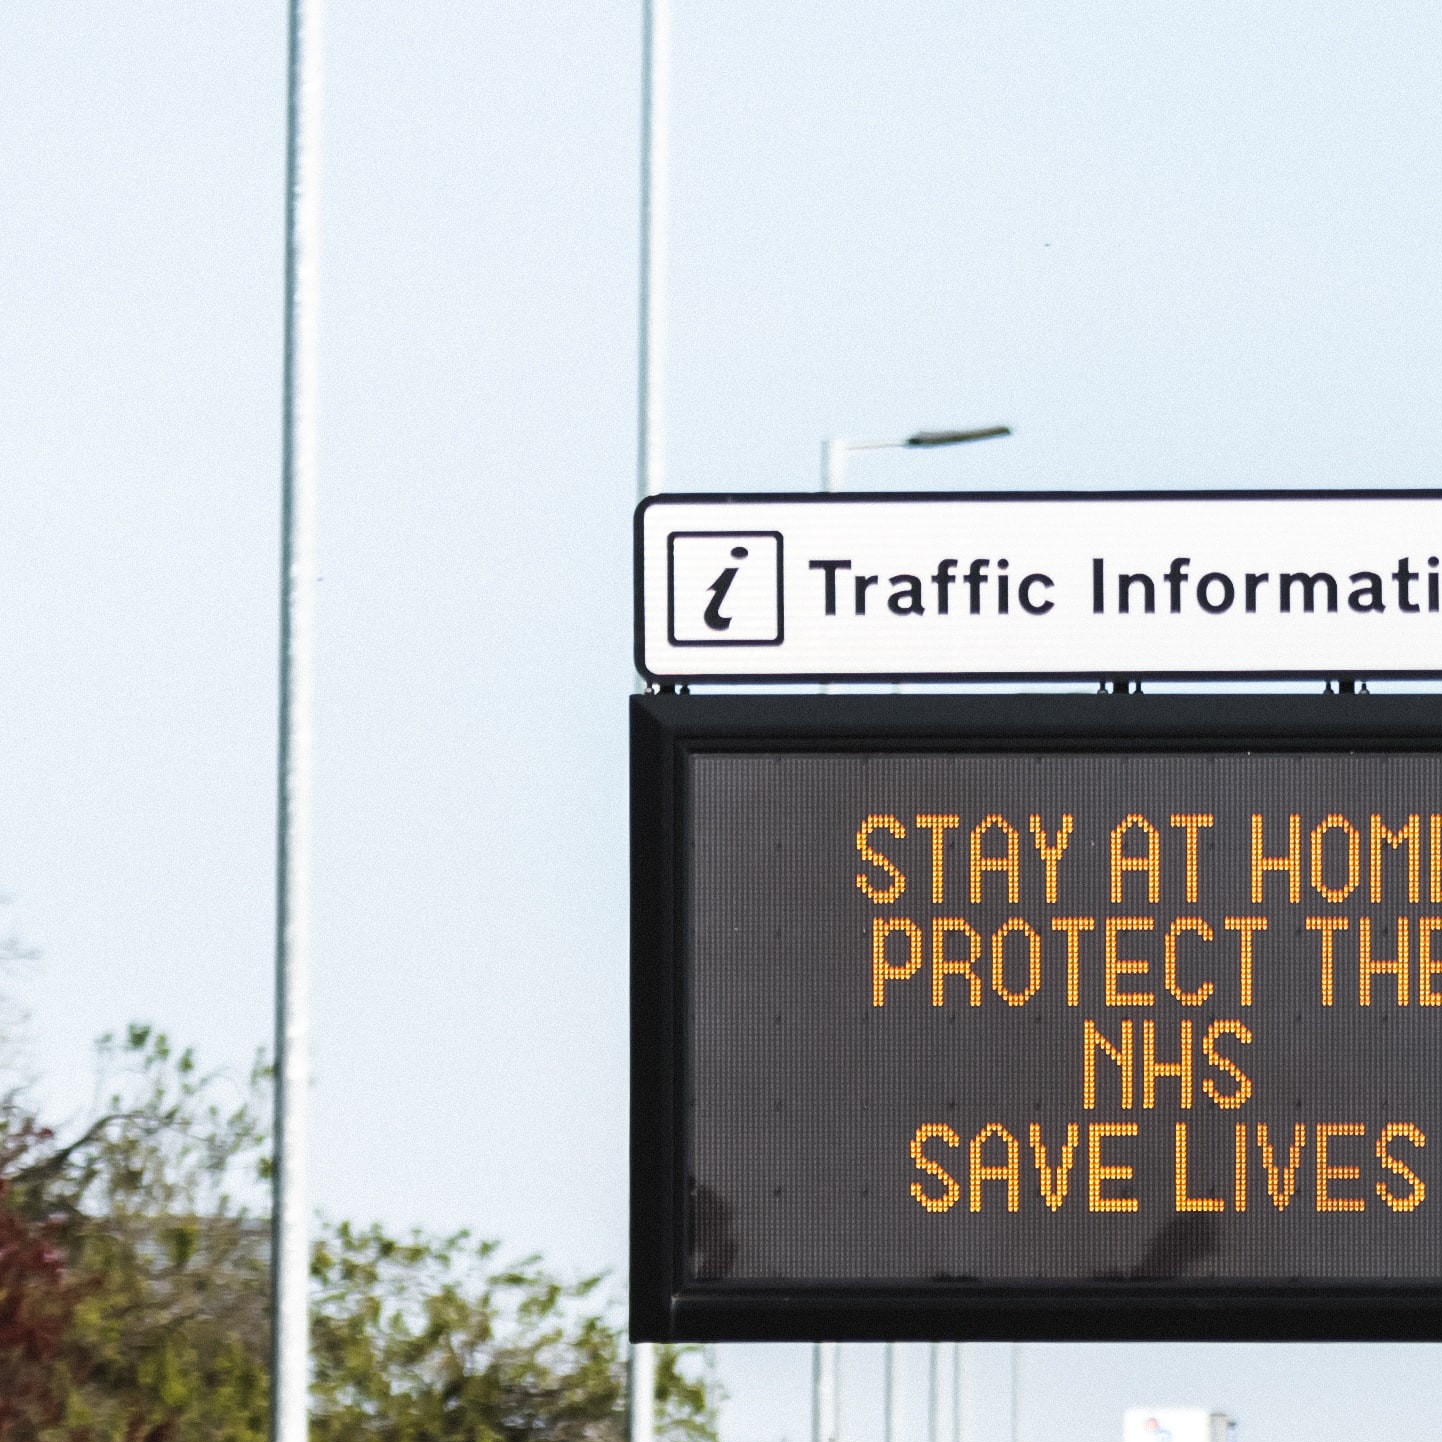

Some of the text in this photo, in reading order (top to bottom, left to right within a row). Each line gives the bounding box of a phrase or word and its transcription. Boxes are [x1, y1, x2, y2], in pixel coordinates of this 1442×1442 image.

[809, 558, 1055, 616] Traffic
[856, 814, 1075, 905] STAY
[1110, 814, 1215, 905] AT
[872, 917, 1270, 1008] PROTECT
[1083, 1020, 1253, 1111] NHS
[910, 1122, 1427, 1214] SAVE LIVES
